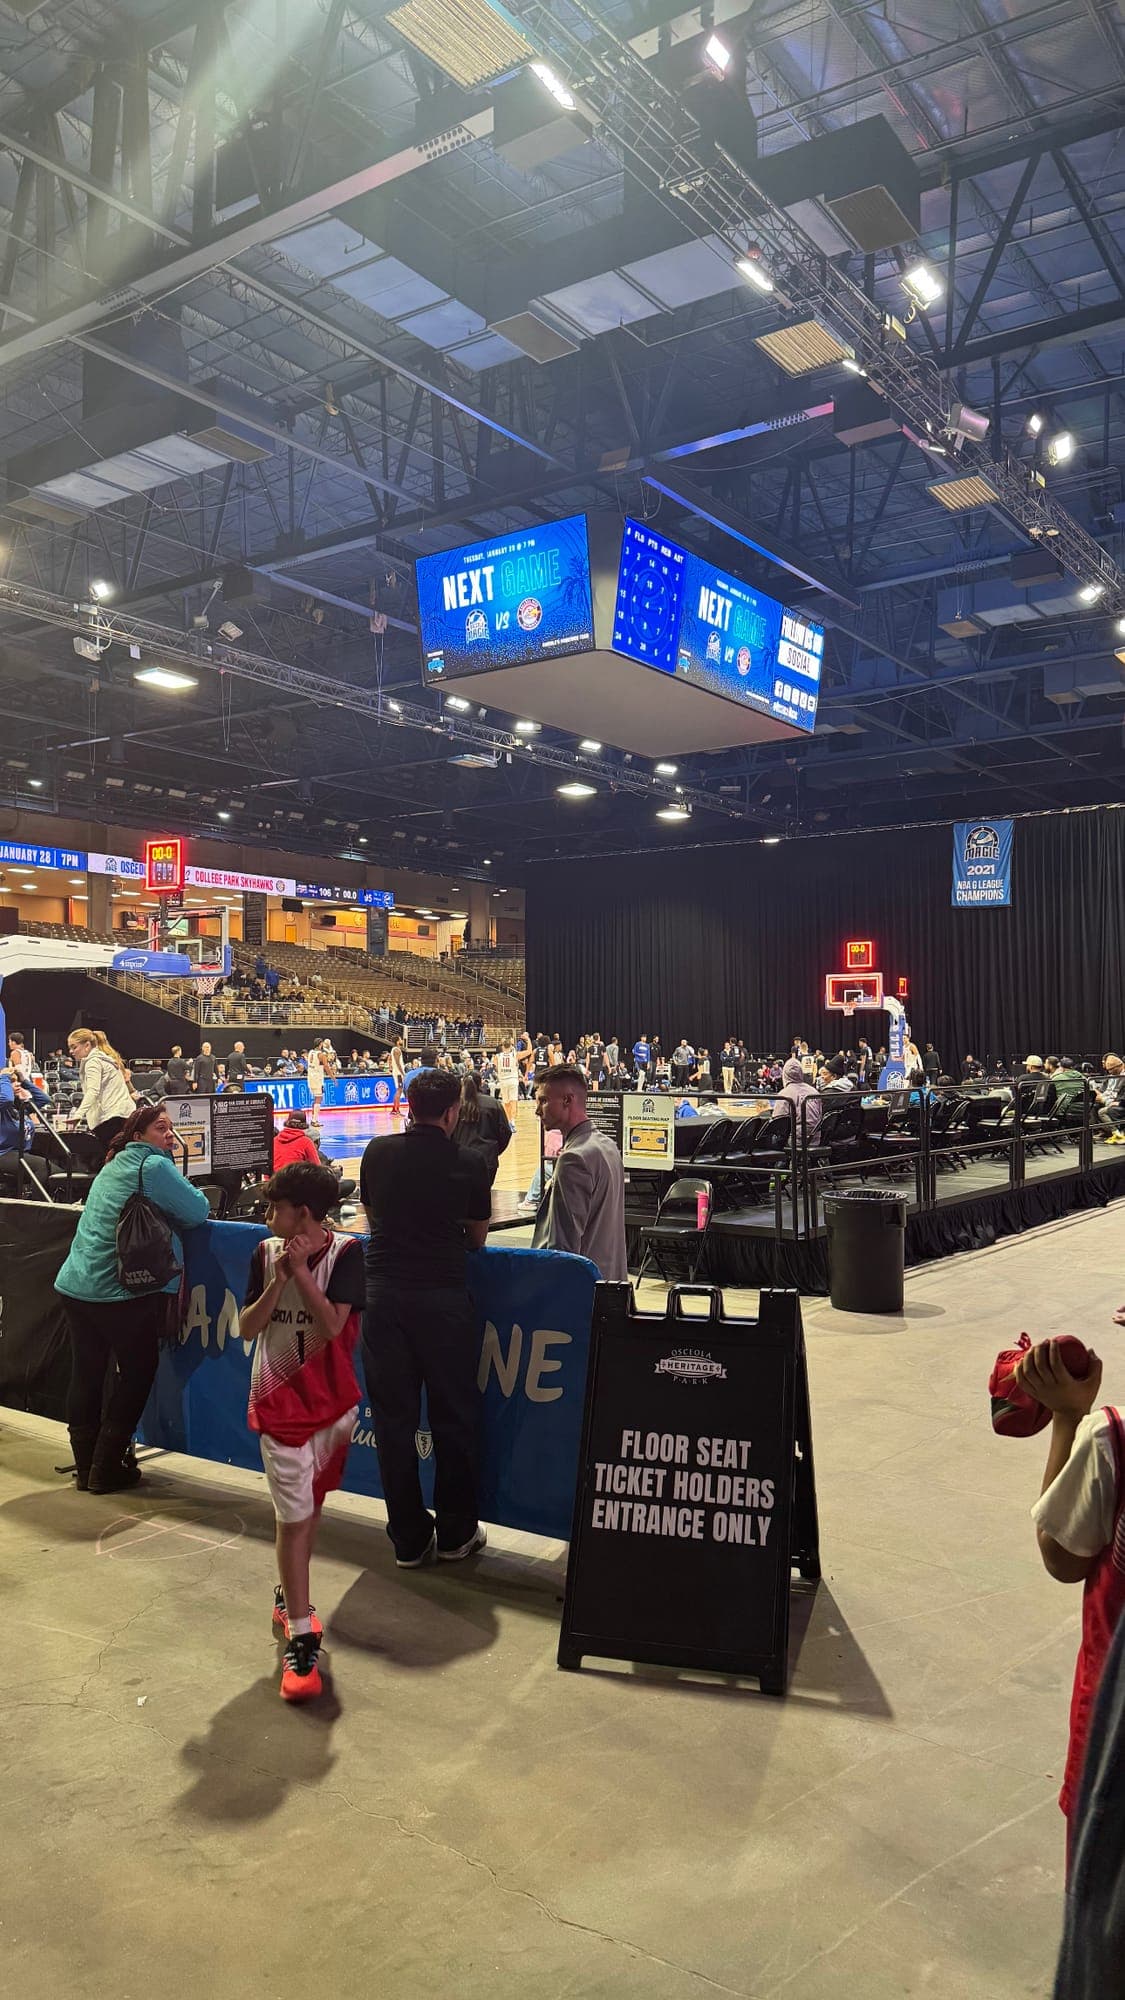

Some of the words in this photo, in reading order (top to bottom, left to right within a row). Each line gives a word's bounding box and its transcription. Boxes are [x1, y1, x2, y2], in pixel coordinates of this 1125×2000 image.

[442, 566, 495, 611] NEXT
[500, 548, 562, 597] GAME
[495, 611, 510, 630] VS
[698, 585, 733, 632] NEXT
[733, 604, 767, 649] GAME
[787, 647, 811, 674] SOCIAL
[0, 845, 38, 863] JANUARY
[39, 850, 51, 864] 28
[61, 853, 79, 867] 7PM
[964, 846, 1000, 862] MAGIC
[120, 860, 144, 876] OSCEO
[966, 864, 995, 876] 2021
[195, 870, 223, 885] COLLEGE
[223, 875, 240, 887] PARK
[240, 877, 274, 891] SKYHAWKS
[957, 880, 971, 890] NBA
[972, 881, 977, 889] G
[978, 879, 1004, 889] LEAGUE
[956, 889, 1004, 901] CHAMPIONS
[295, 1330, 305, 1364] 1
[671, 1348, 712, 1359] OSCEOLA
[477, 1319, 573, 1403] NE
[667, 1361, 714, 1372] HERITAGE
[620, 1429, 690, 1464] FLOOR
[696, 1436, 752, 1471] SEAT
[594, 1462, 667, 1498] TICKET
[673, 1470, 776, 1510] HOLDERS
[591, 1498, 705, 1541] ENTRANCE
[712, 1510, 772, 1547] ONLY
